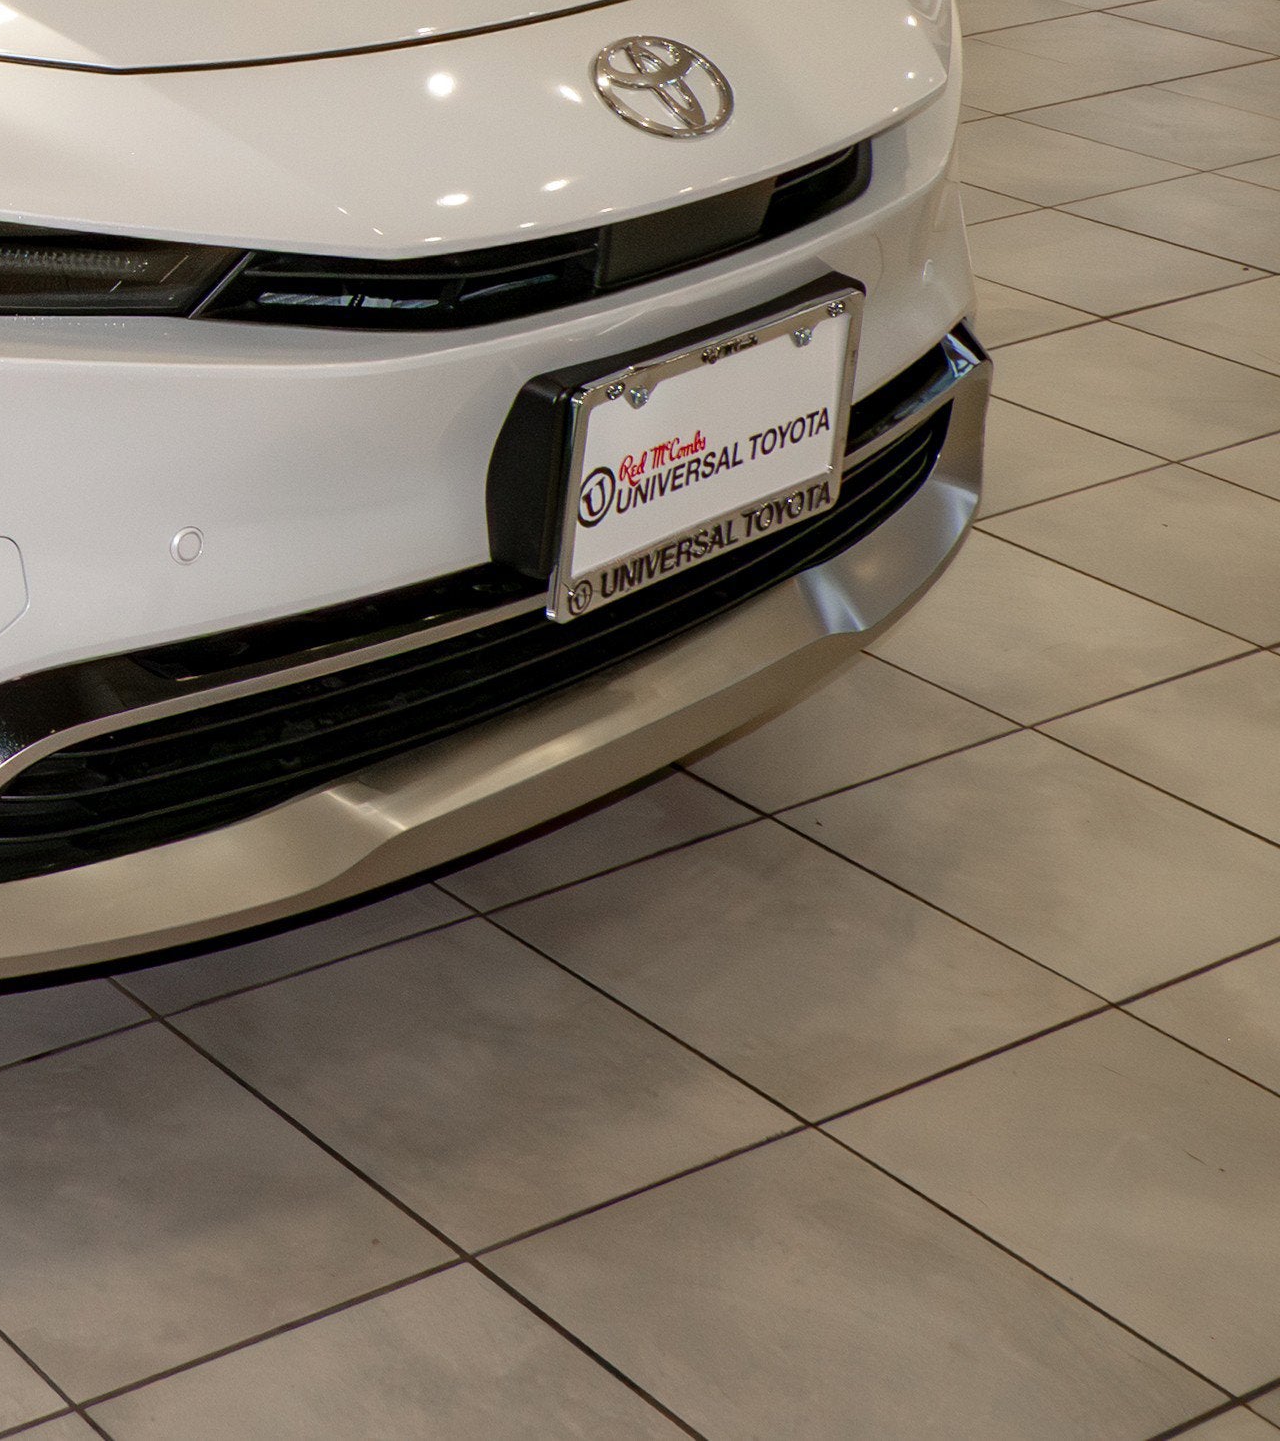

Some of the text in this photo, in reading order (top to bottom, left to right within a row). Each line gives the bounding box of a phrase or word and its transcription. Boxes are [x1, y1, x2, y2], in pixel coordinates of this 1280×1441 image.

[615, 407, 831, 514] UNIVERSAL TOYOTA
[618, 429, 707, 487] Red McCombs
[600, 519, 739, 599] UNIVERSAL
[741, 481, 832, 538] TOYOTA
